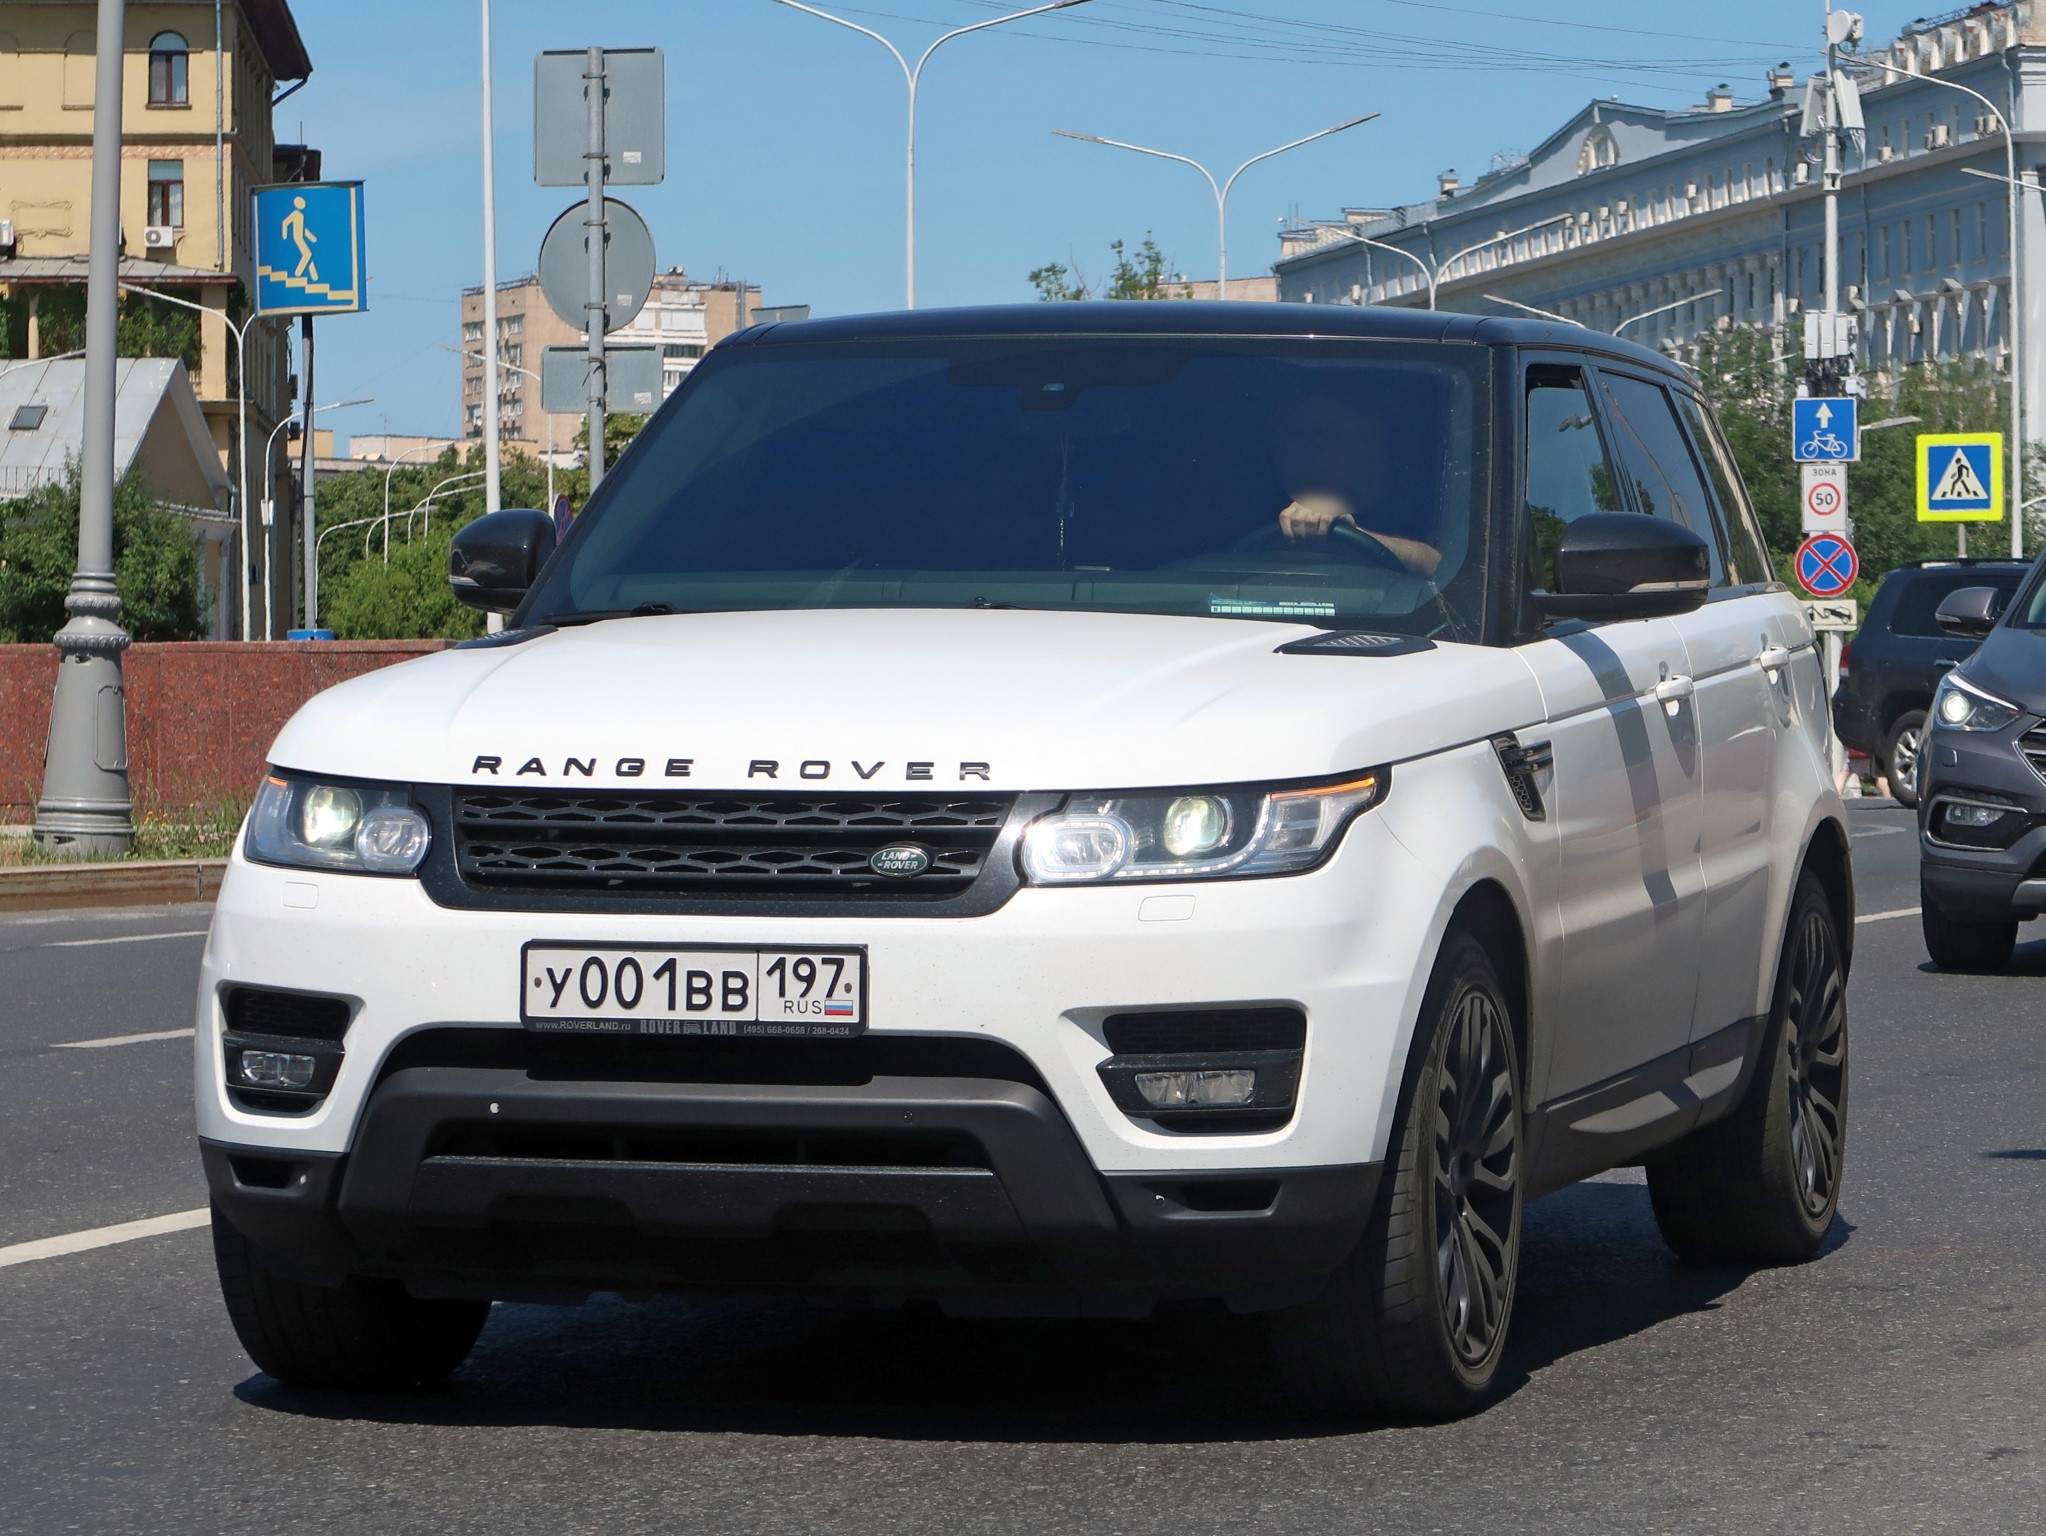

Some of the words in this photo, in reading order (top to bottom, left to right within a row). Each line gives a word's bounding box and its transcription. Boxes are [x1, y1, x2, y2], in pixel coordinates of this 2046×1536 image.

[1811, 468, 1837, 477] ЗОНА
[1816, 493, 1834, 506] 50
[472, 755, 694, 777] RANGE
[747, 759, 991, 781] ROVER
[765, 956, 846, 998] 197
[783, 1000, 822, 1015] RUS
[535, 1020, 631, 1031] www.ROVERLAND.ru
[640, 1019, 681, 1034] ROVER
[703, 1022, 736, 1035] LAND
[743, 1025, 765, 1035] (495)
